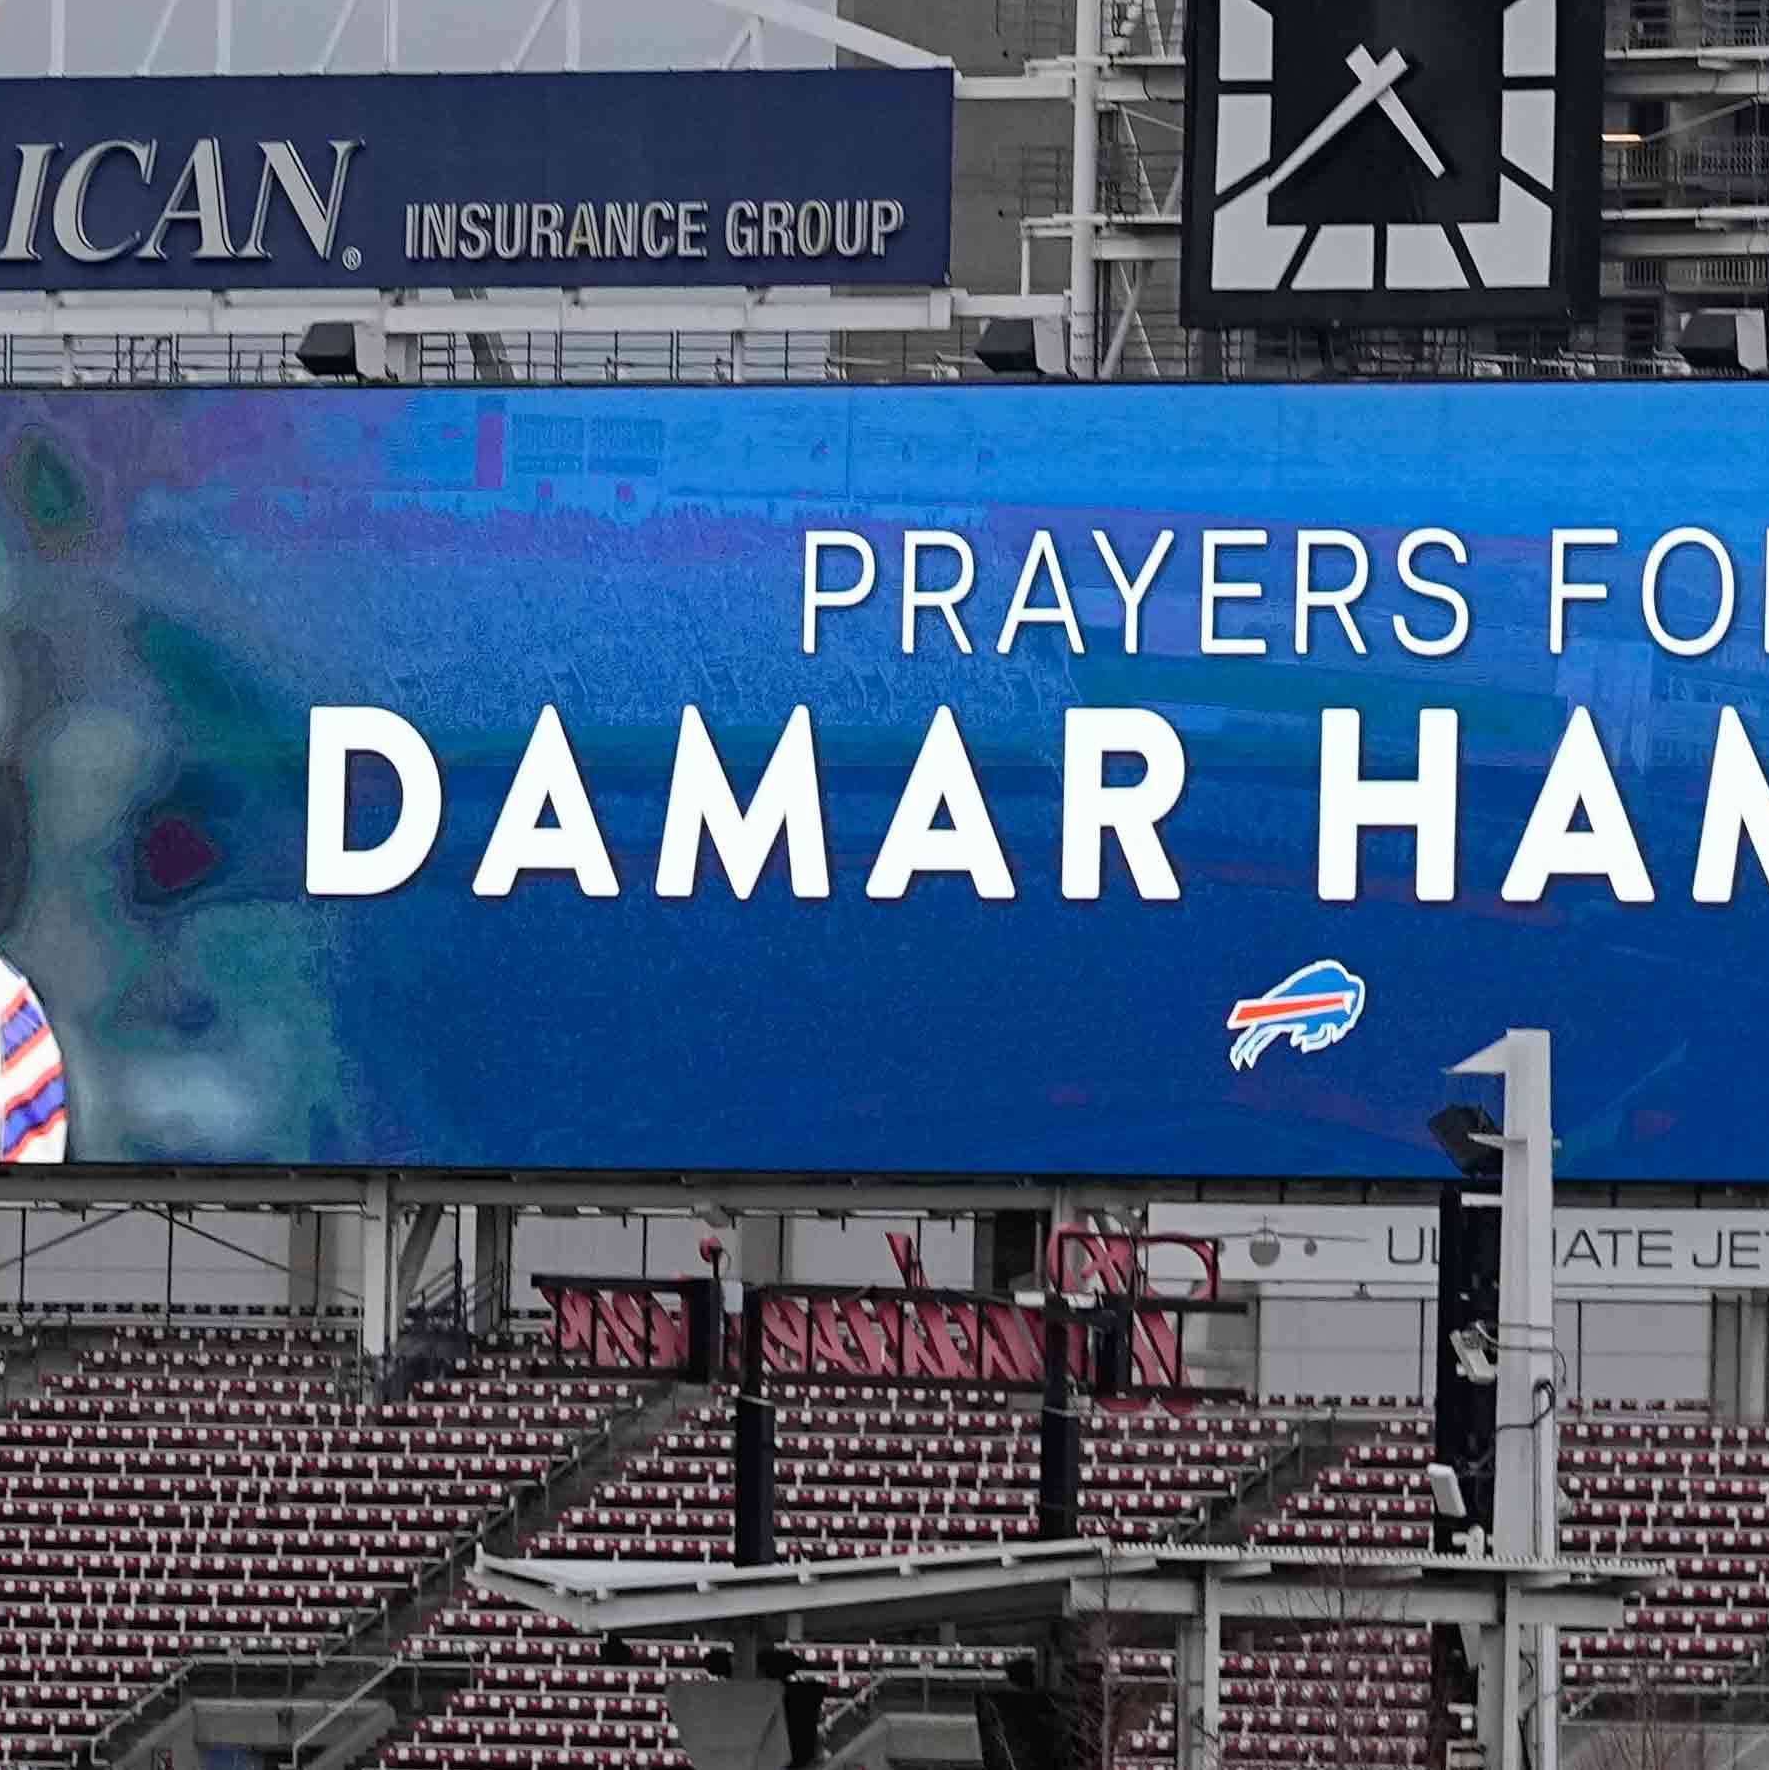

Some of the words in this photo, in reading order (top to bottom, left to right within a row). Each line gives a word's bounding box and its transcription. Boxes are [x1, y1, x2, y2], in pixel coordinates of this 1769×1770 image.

[406, 200, 706, 259] INSURANCE
[725, 199, 904, 258] GROUP
[802, 528, 1470, 657] PRAYERS
[305, 704, 1186, 901] DAMAR
